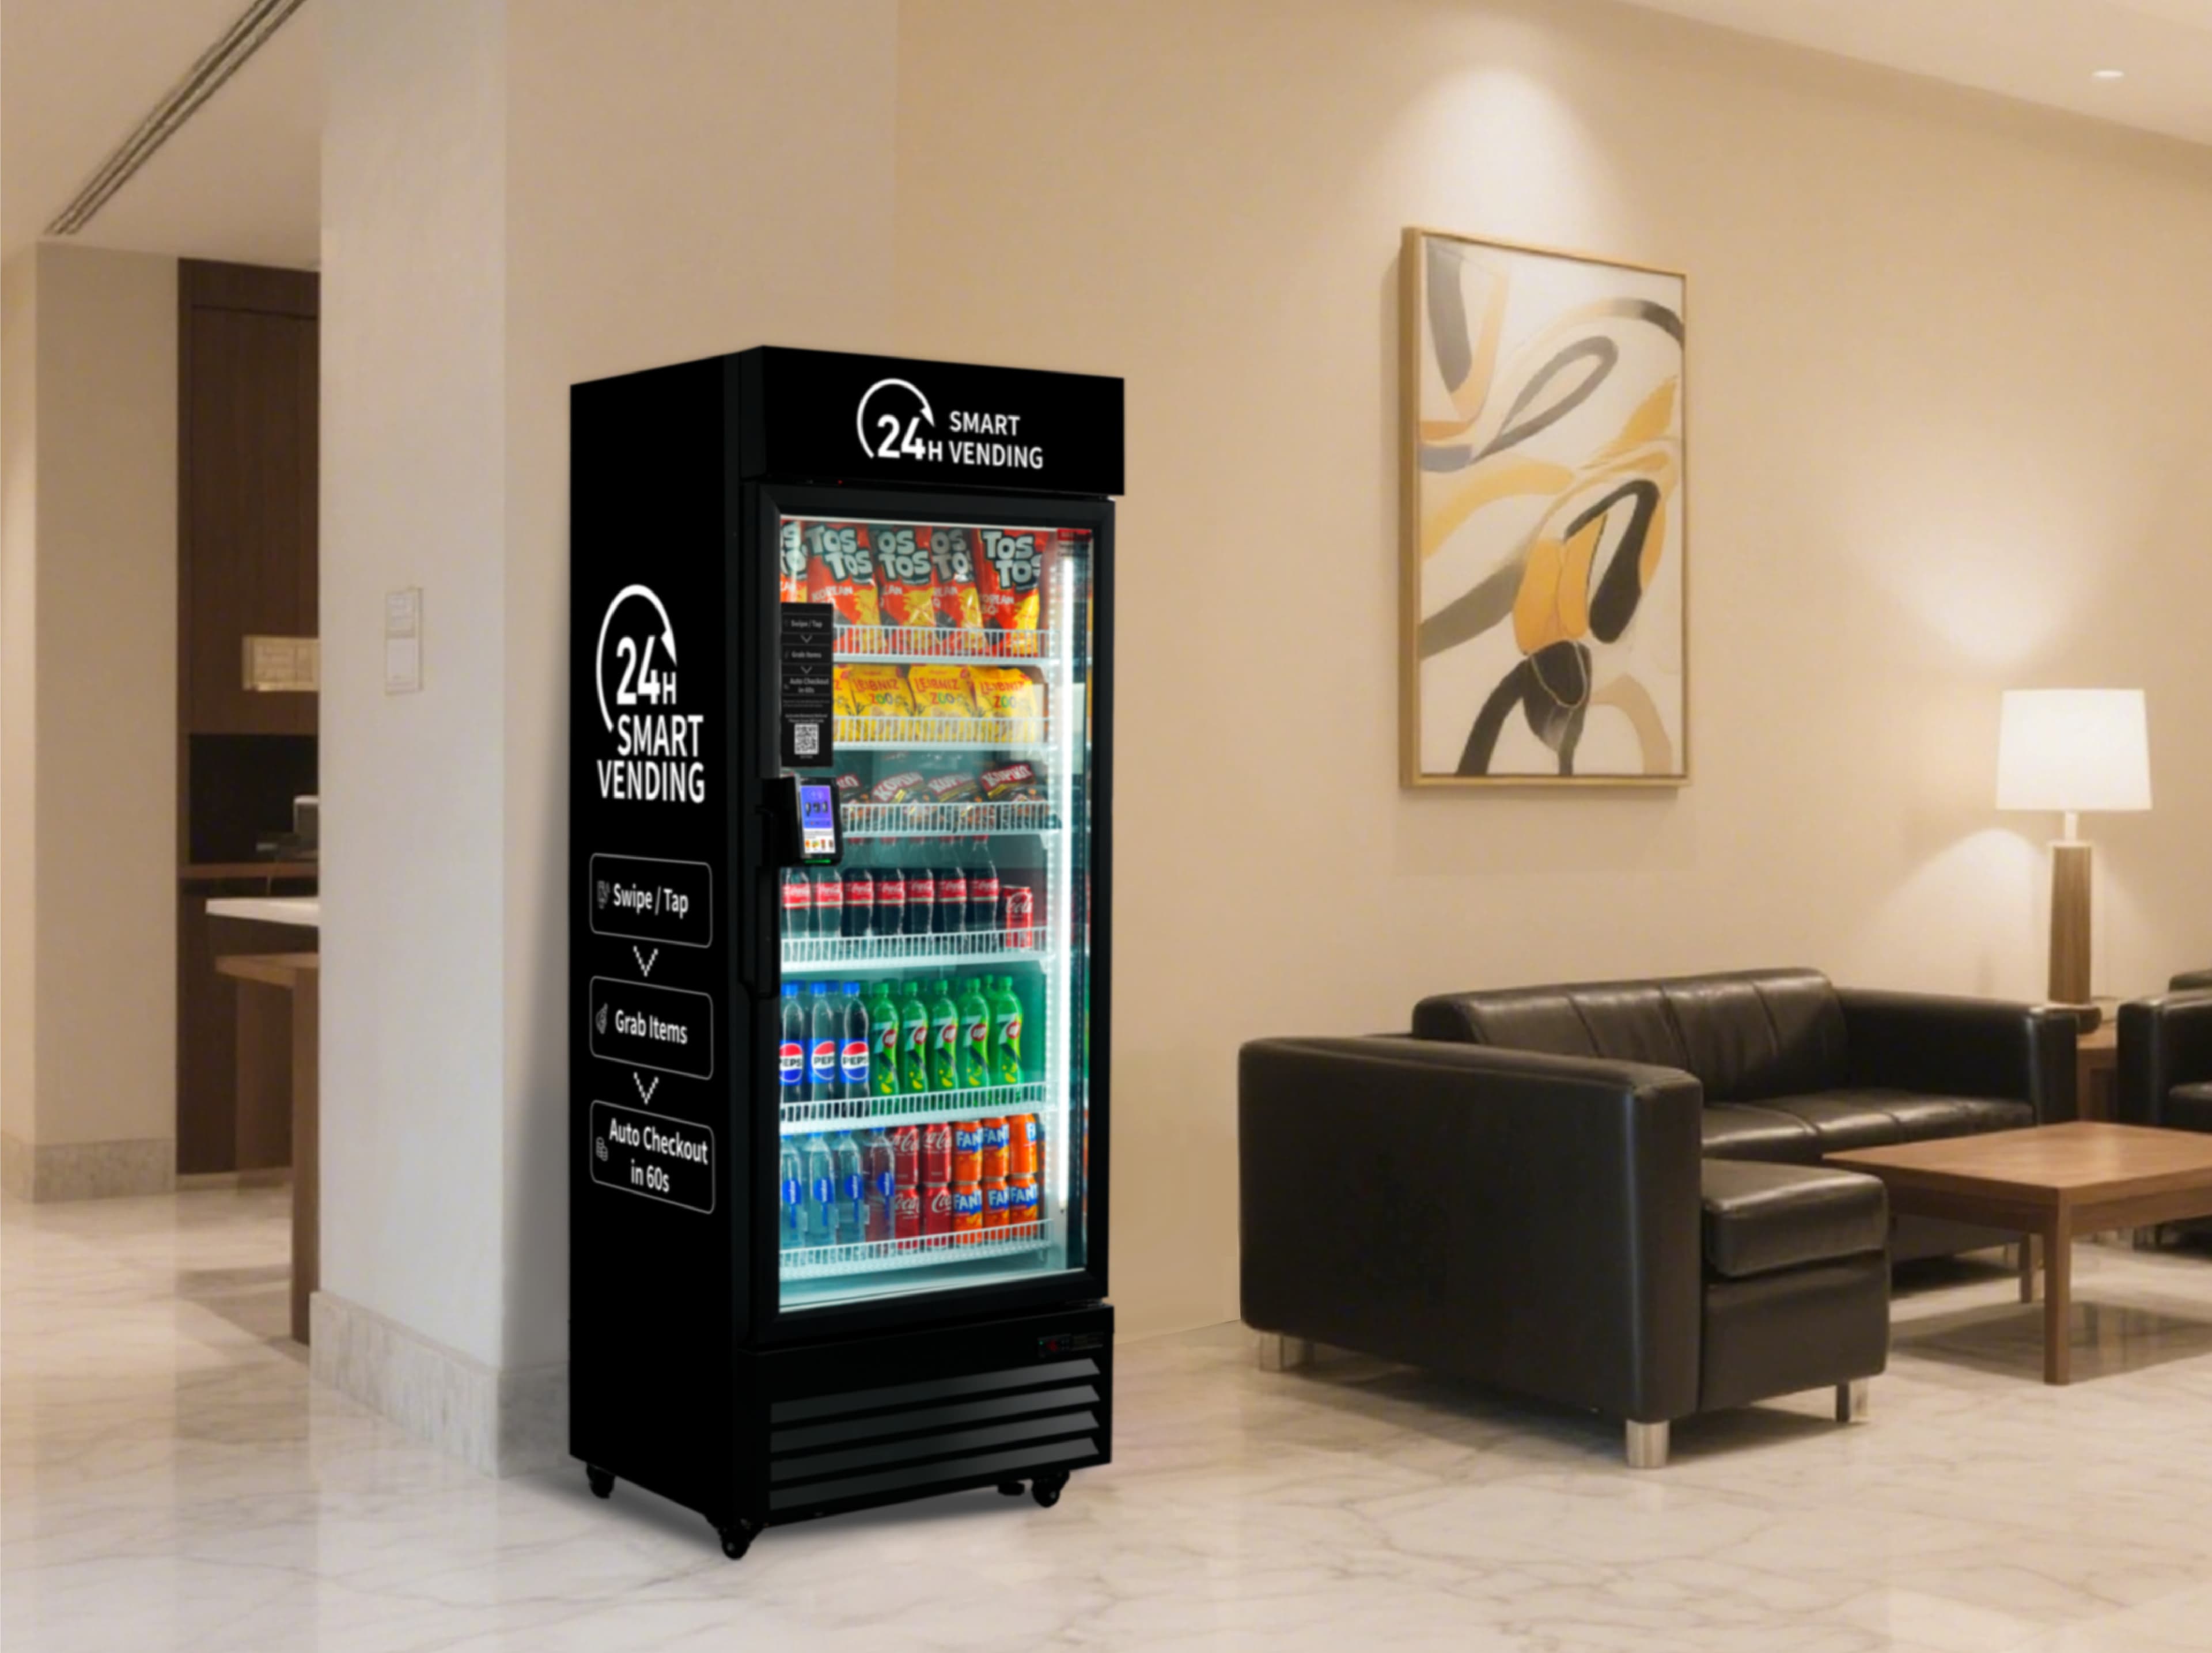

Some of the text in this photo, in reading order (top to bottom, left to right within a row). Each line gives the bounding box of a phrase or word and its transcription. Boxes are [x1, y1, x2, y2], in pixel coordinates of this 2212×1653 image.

[877, 414, 943, 462] 24H
[949, 410, 1020, 436] SMART
[948, 441, 1043, 469] VENDING
[805, 525, 857, 555] TOS
[982, 530, 1035, 560] TOS
[824, 549, 873, 579] TOS
[878, 550, 931, 579] TOS
[616, 635, 677, 706] 24H
[853, 678, 899, 693] LEIBNIZ
[914, 677, 960, 693] LEIBNIZ
[869, 692, 893, 706] ZOO
[930, 691, 955, 705] ZOO
[993, 695, 1017, 709] ZOO
[616, 714, 704, 757] SMART
[597, 759, 705, 804] VENDING
[612, 882, 688, 919] Swipe / Tap
[615, 1009, 688, 1045] Grab Items
[609, 1117, 709, 1165] Auto Checkout
[630, 1158, 670, 1193] in 60s
